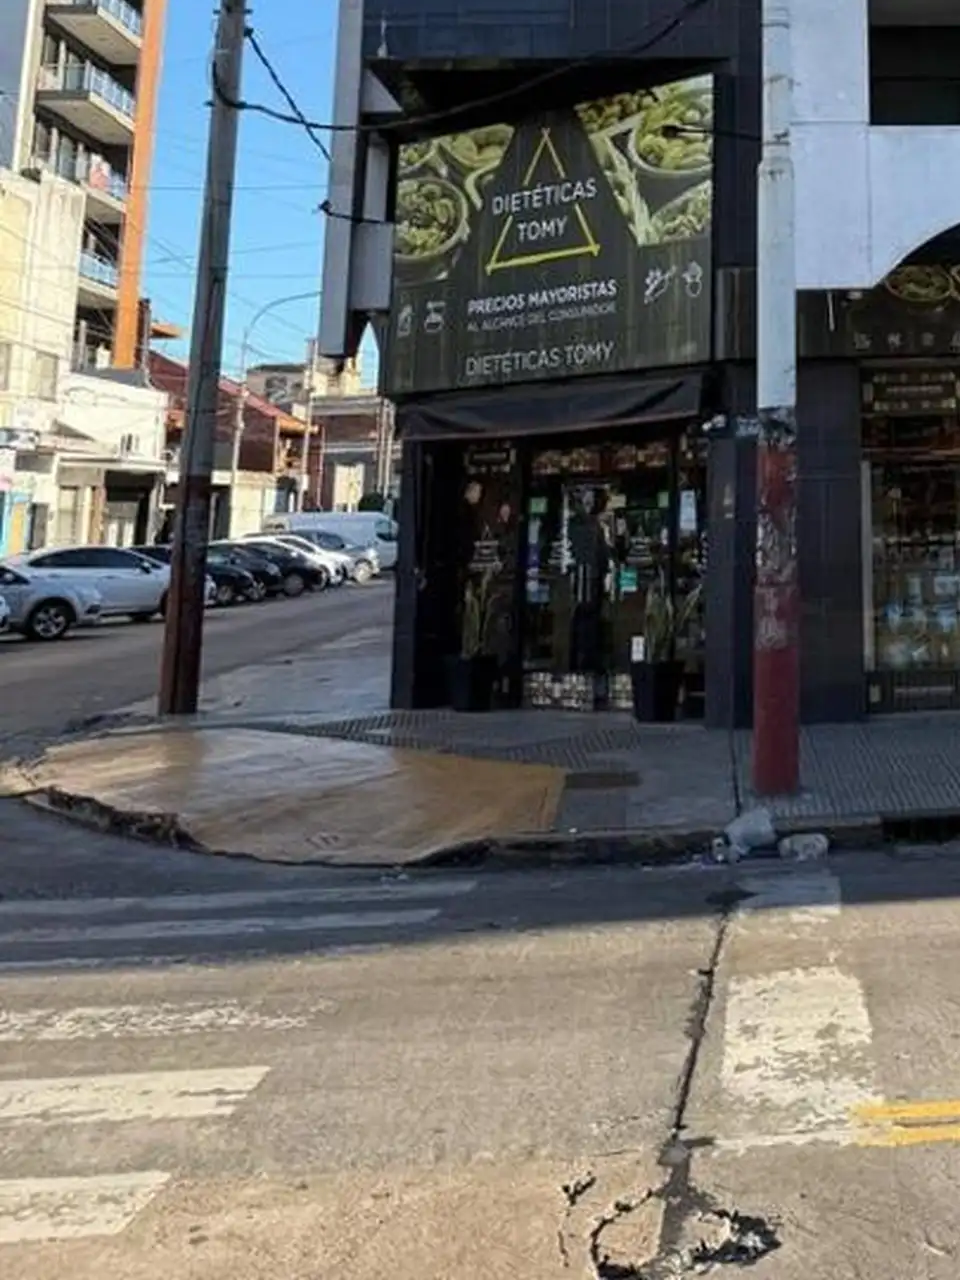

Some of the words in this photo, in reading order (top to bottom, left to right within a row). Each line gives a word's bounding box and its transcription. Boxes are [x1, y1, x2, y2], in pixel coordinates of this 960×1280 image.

[491, 177, 598, 216] DIETÉTICAS
[516, 215, 568, 243] TOMY
[467, 293, 526, 315] PRECIOS
[527, 278, 618, 307] MAYORISTAS
[465, 347, 562, 376] DIETÉTICAS
[562, 340, 615, 366] TOMY
